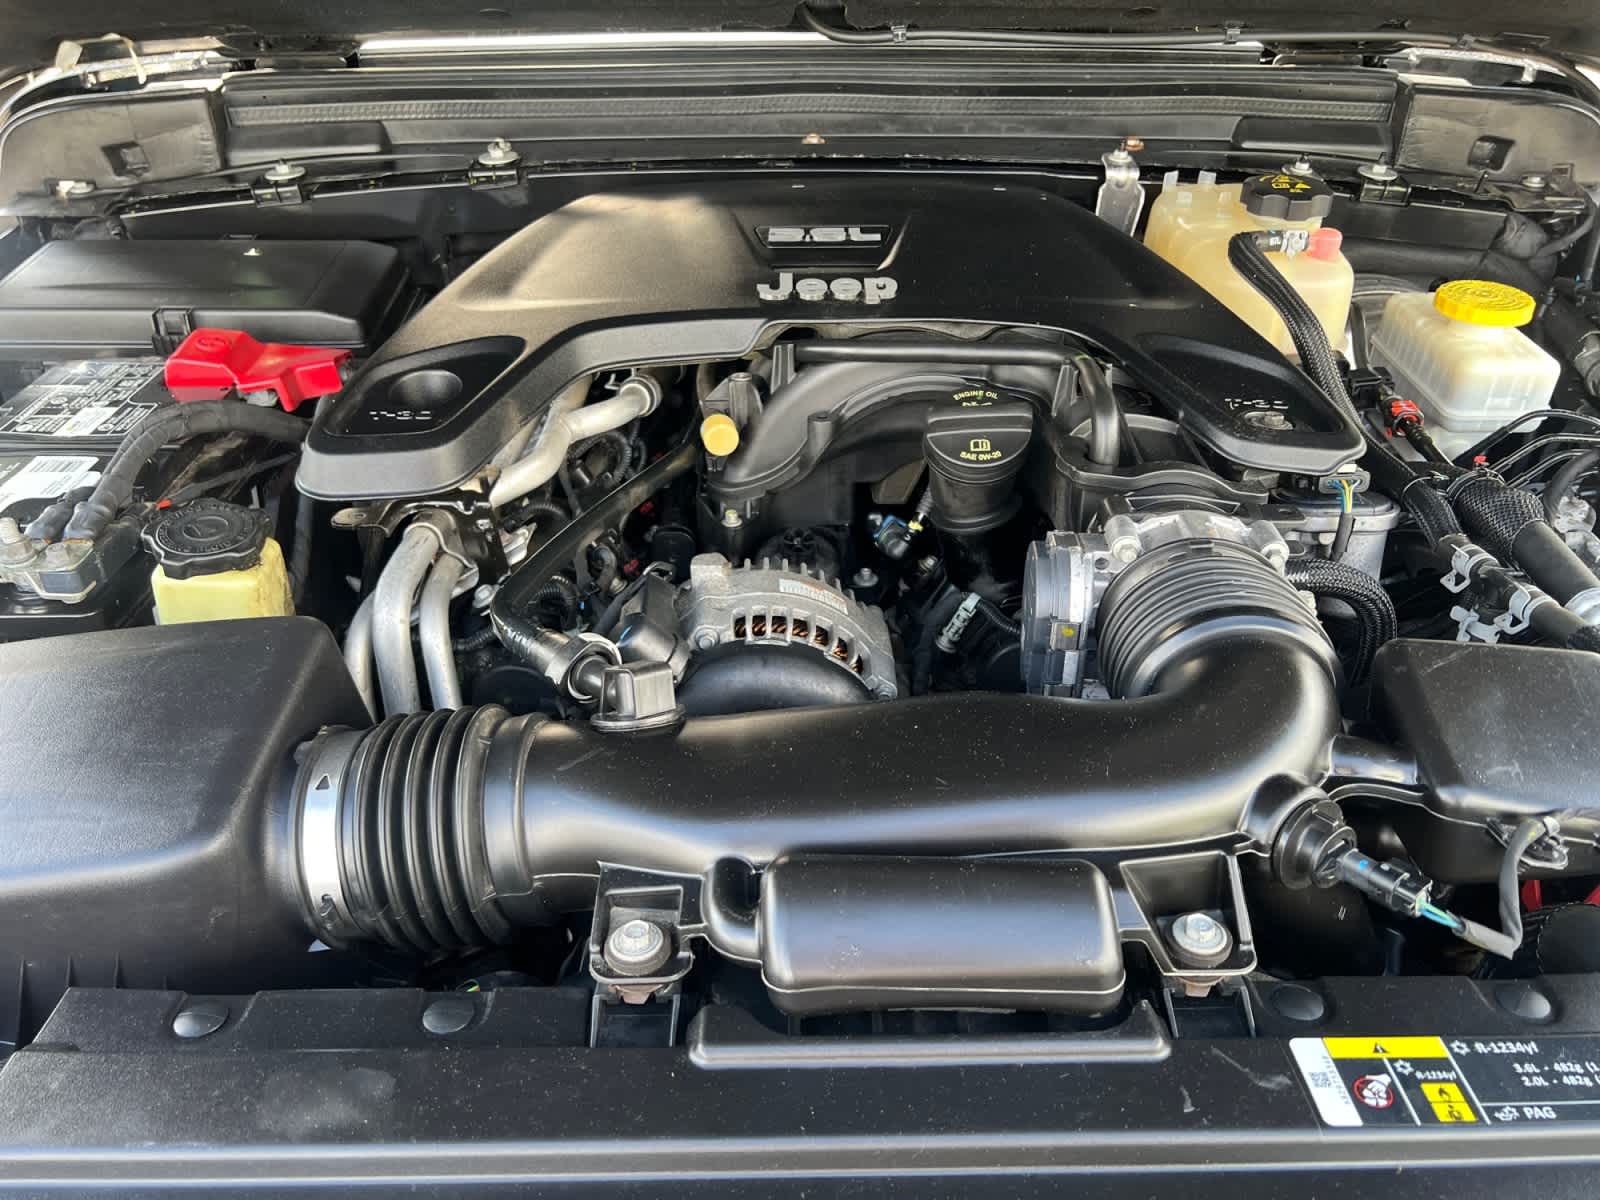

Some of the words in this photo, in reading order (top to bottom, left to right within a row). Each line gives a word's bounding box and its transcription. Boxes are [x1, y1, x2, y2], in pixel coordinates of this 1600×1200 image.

[756, 272, 898, 304] Jeep
[953, 390, 985, 401] ENGINE
[985, 391, 998, 400] OIL
[1474, 1041, 1539, 1055] R-1234yf
[1512, 1062, 1540, 1073] 3.6L
[1521, 1076, 1549, 1087] 2.0L
[1523, 1106, 1557, 1119] PAG
